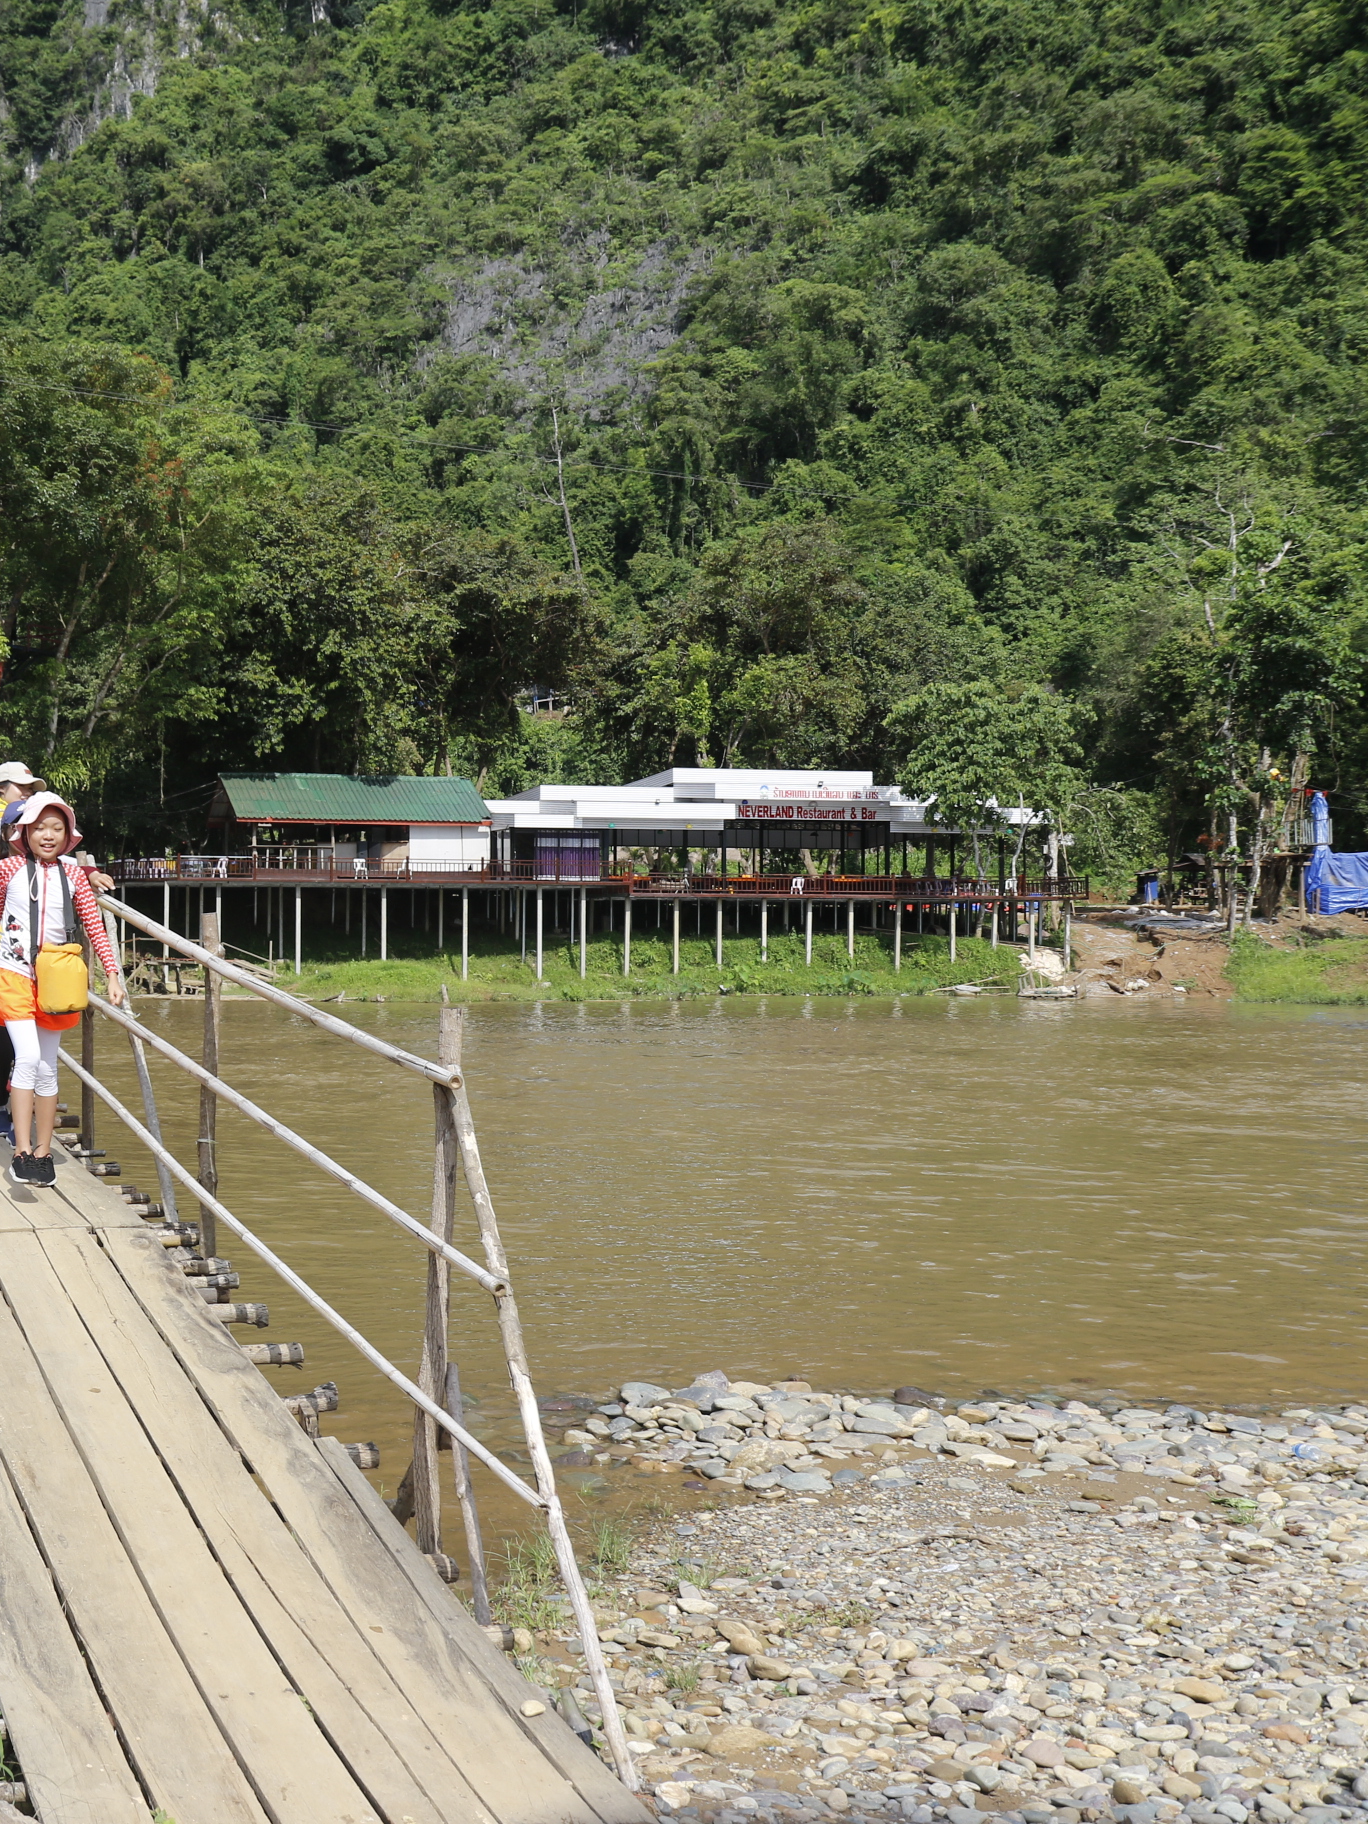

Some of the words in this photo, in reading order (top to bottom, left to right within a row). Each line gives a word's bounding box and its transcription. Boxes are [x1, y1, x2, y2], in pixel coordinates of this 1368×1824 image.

[738, 805, 794, 819] NEVERLAND
[797, 806, 845, 820] Restaurant
[850, 807, 857, 819] &
[861, 807, 877, 820] Bar
